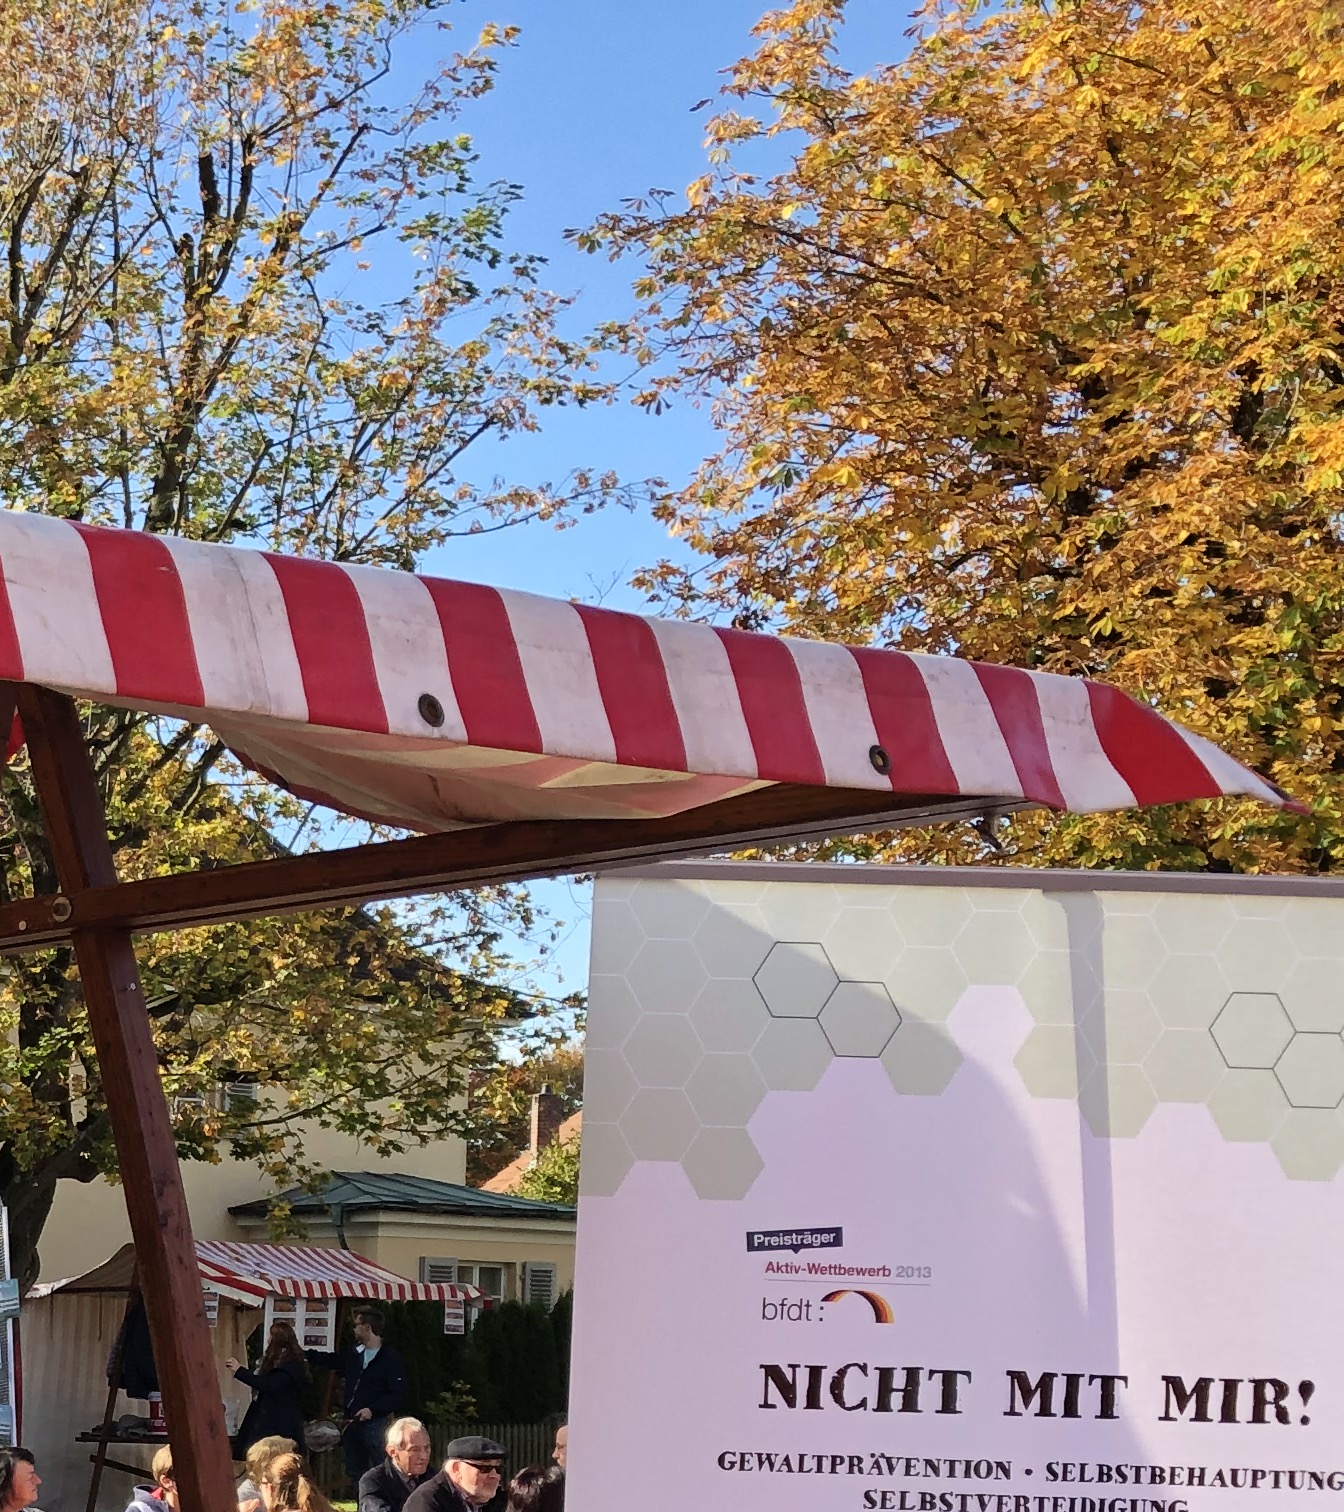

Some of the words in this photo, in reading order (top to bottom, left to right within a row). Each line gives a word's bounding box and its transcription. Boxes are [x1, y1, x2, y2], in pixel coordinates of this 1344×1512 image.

[753, 1231, 836, 1247] Preisträger
[764, 1261, 892, 1278] Aktiv-Wettbewerb
[896, 1265, 932, 1279] 2013
[758, 1362, 972, 1414] NICHT
[1003, 1370, 1129, 1420] MIT
[1158, 1375, 1316, 1426] MIR!
[717, 1451, 1013, 1481] GEWALTPRÄVENTION
[1045, 1460, 1344, 1492] SELBSTBEHAUPTUNG
